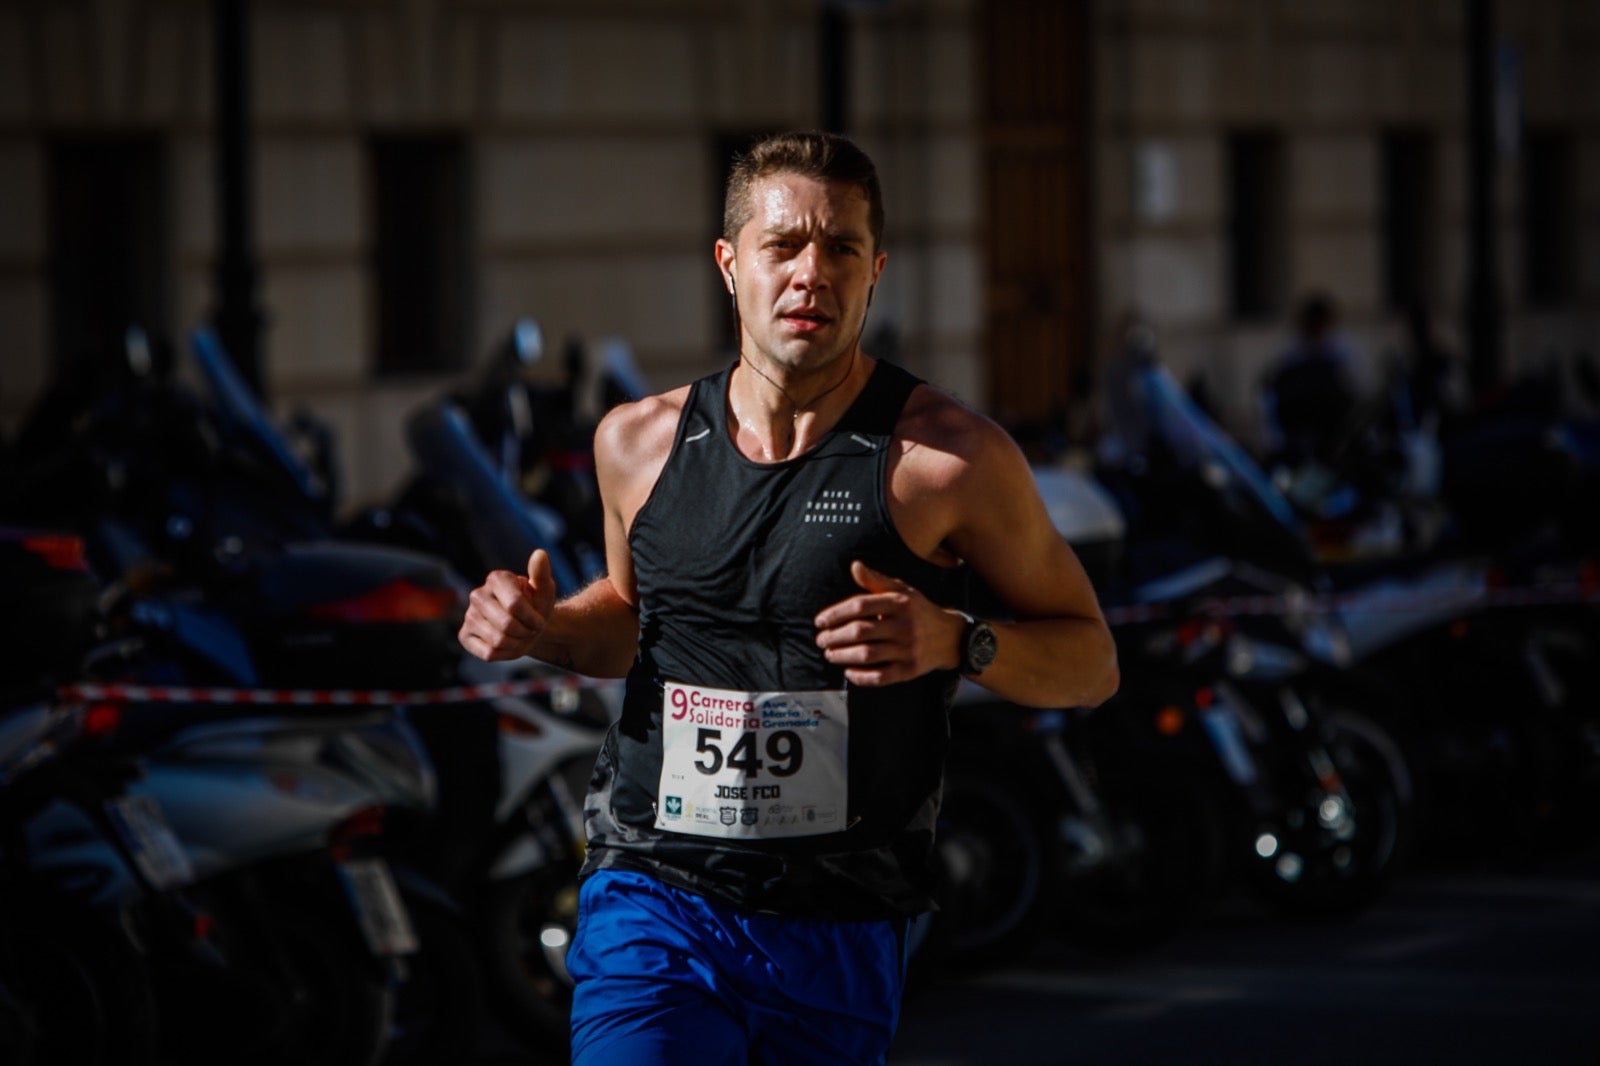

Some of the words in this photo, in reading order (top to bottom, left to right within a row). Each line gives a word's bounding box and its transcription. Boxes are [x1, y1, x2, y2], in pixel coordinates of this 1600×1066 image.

[807, 501, 861, 511] RUNNING
[804, 513, 859, 523] DIVISION
[671, 688, 688, 720] 9
[690, 691, 755, 713] Carrera
[689, 708, 760, 729] Solidaria
[762, 718, 819, 728] Granada
[694, 727, 804, 779] 549
[714, 785, 748, 800] JOSE
[752, 785, 780, 800] FCO
